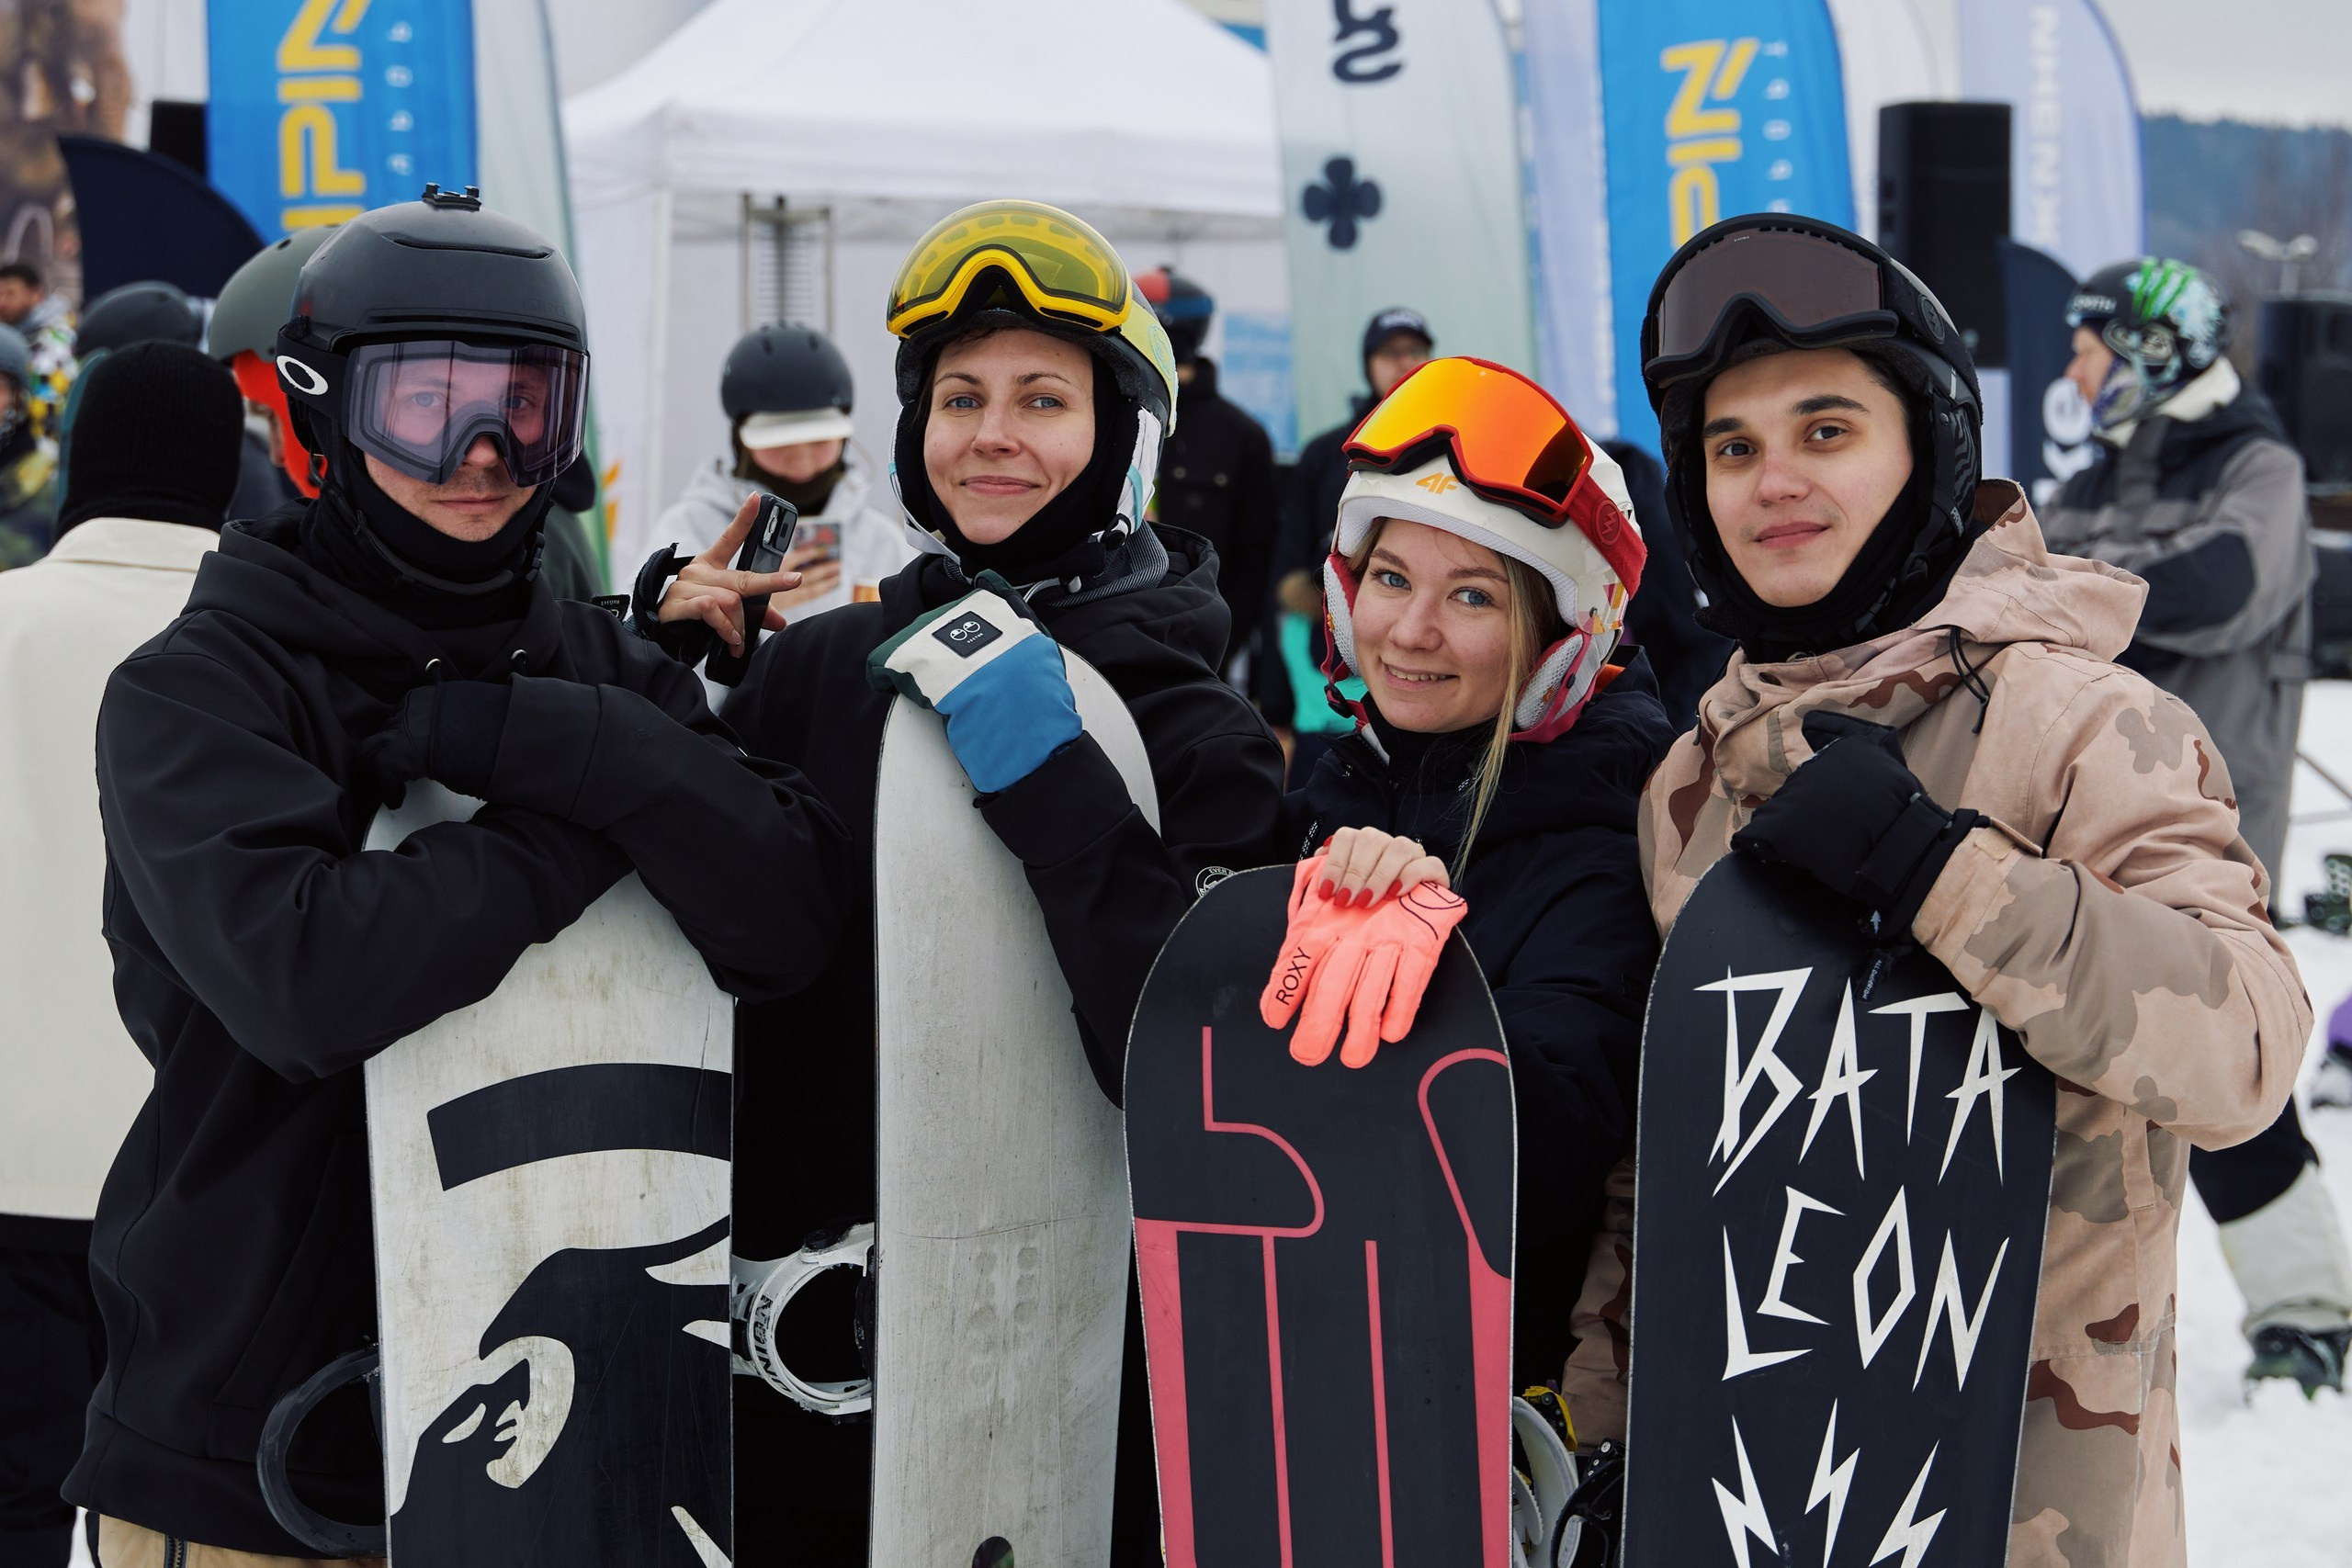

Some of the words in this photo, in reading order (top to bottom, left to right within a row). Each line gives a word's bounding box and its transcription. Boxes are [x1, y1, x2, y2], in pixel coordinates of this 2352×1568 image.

[1416, 472, 1460, 494] 4F
[1275, 947, 1311, 1006] ROXY
[1693, 965, 2022, 1197] BATA
[1721, 1184, 2009, 1393] LEON
[753, 1294, 792, 1393] UNION
